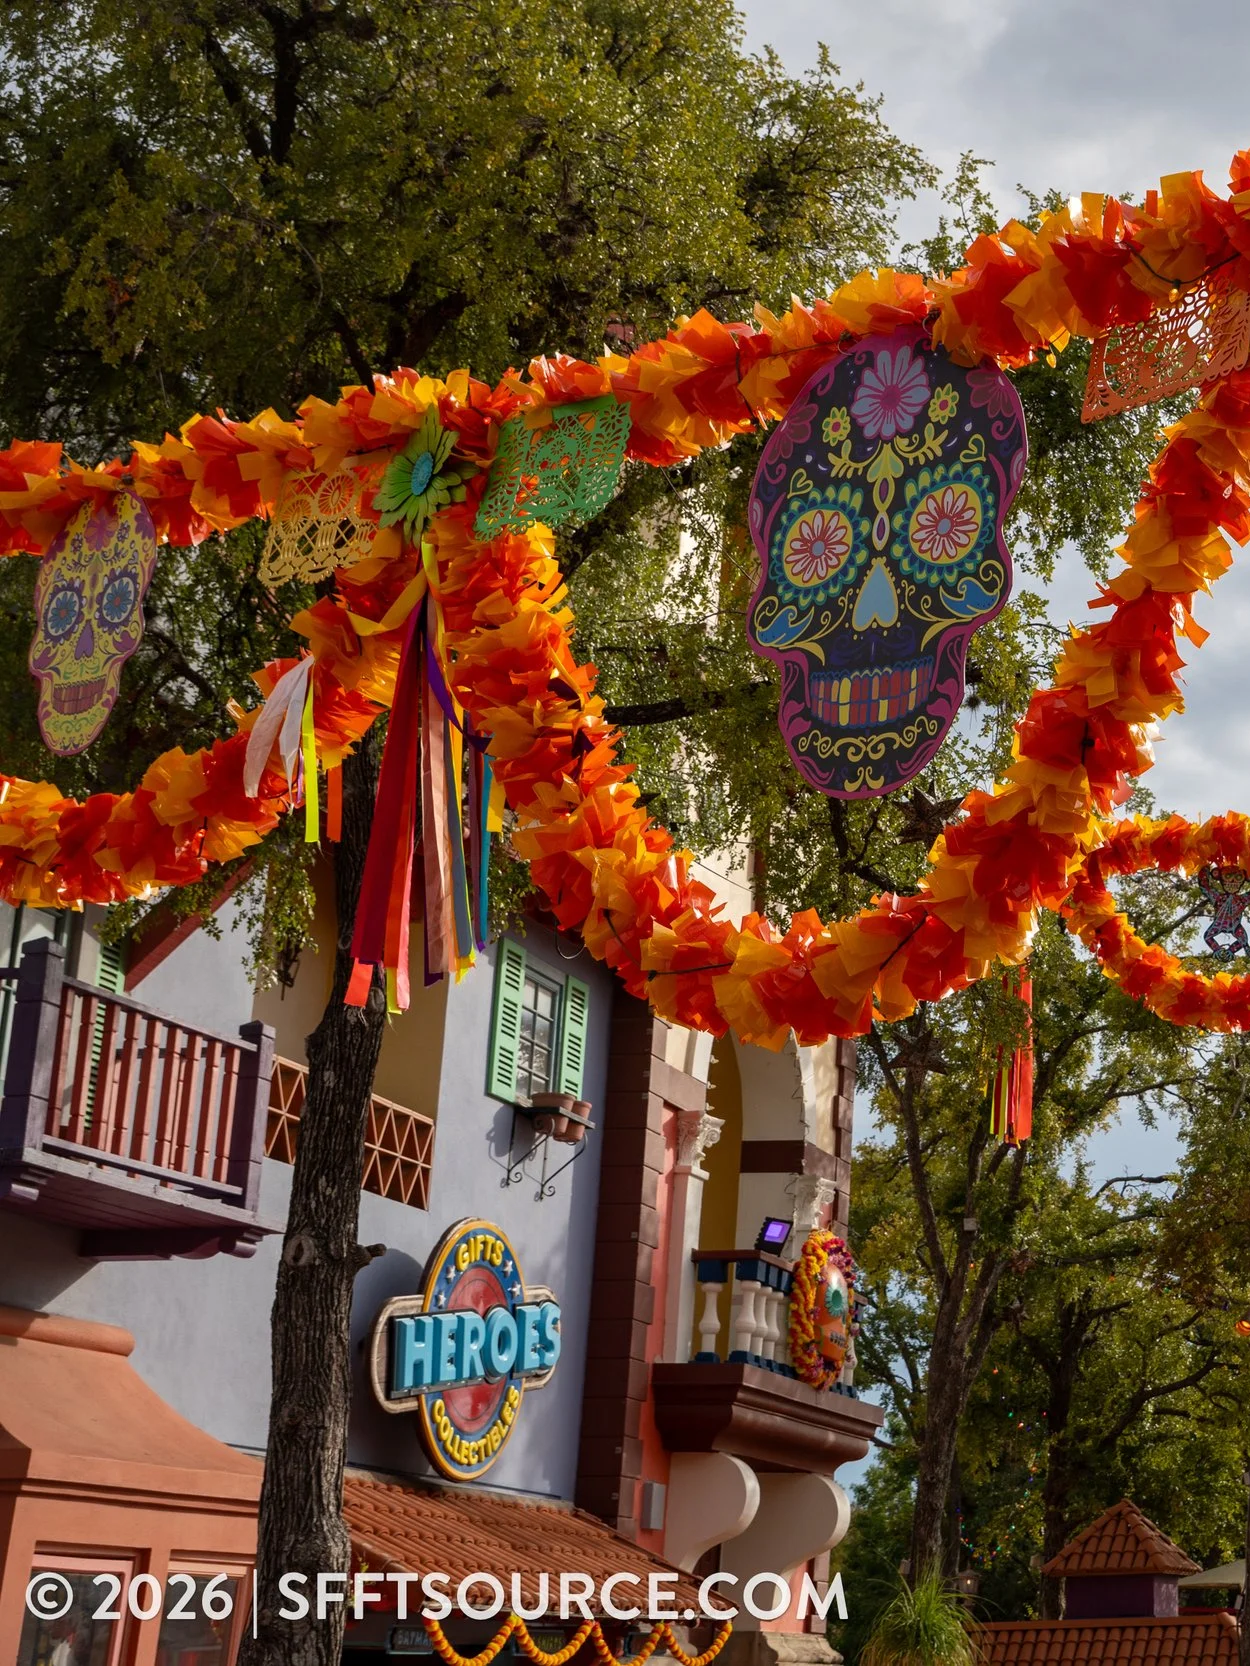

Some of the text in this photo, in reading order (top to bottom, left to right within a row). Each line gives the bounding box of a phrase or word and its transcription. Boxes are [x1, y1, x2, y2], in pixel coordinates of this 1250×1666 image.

[456, 1235, 504, 1272] GIFTS
[393, 1302, 562, 1392] HEROES
[431, 1385, 520, 1466] COLLECTIBLES
